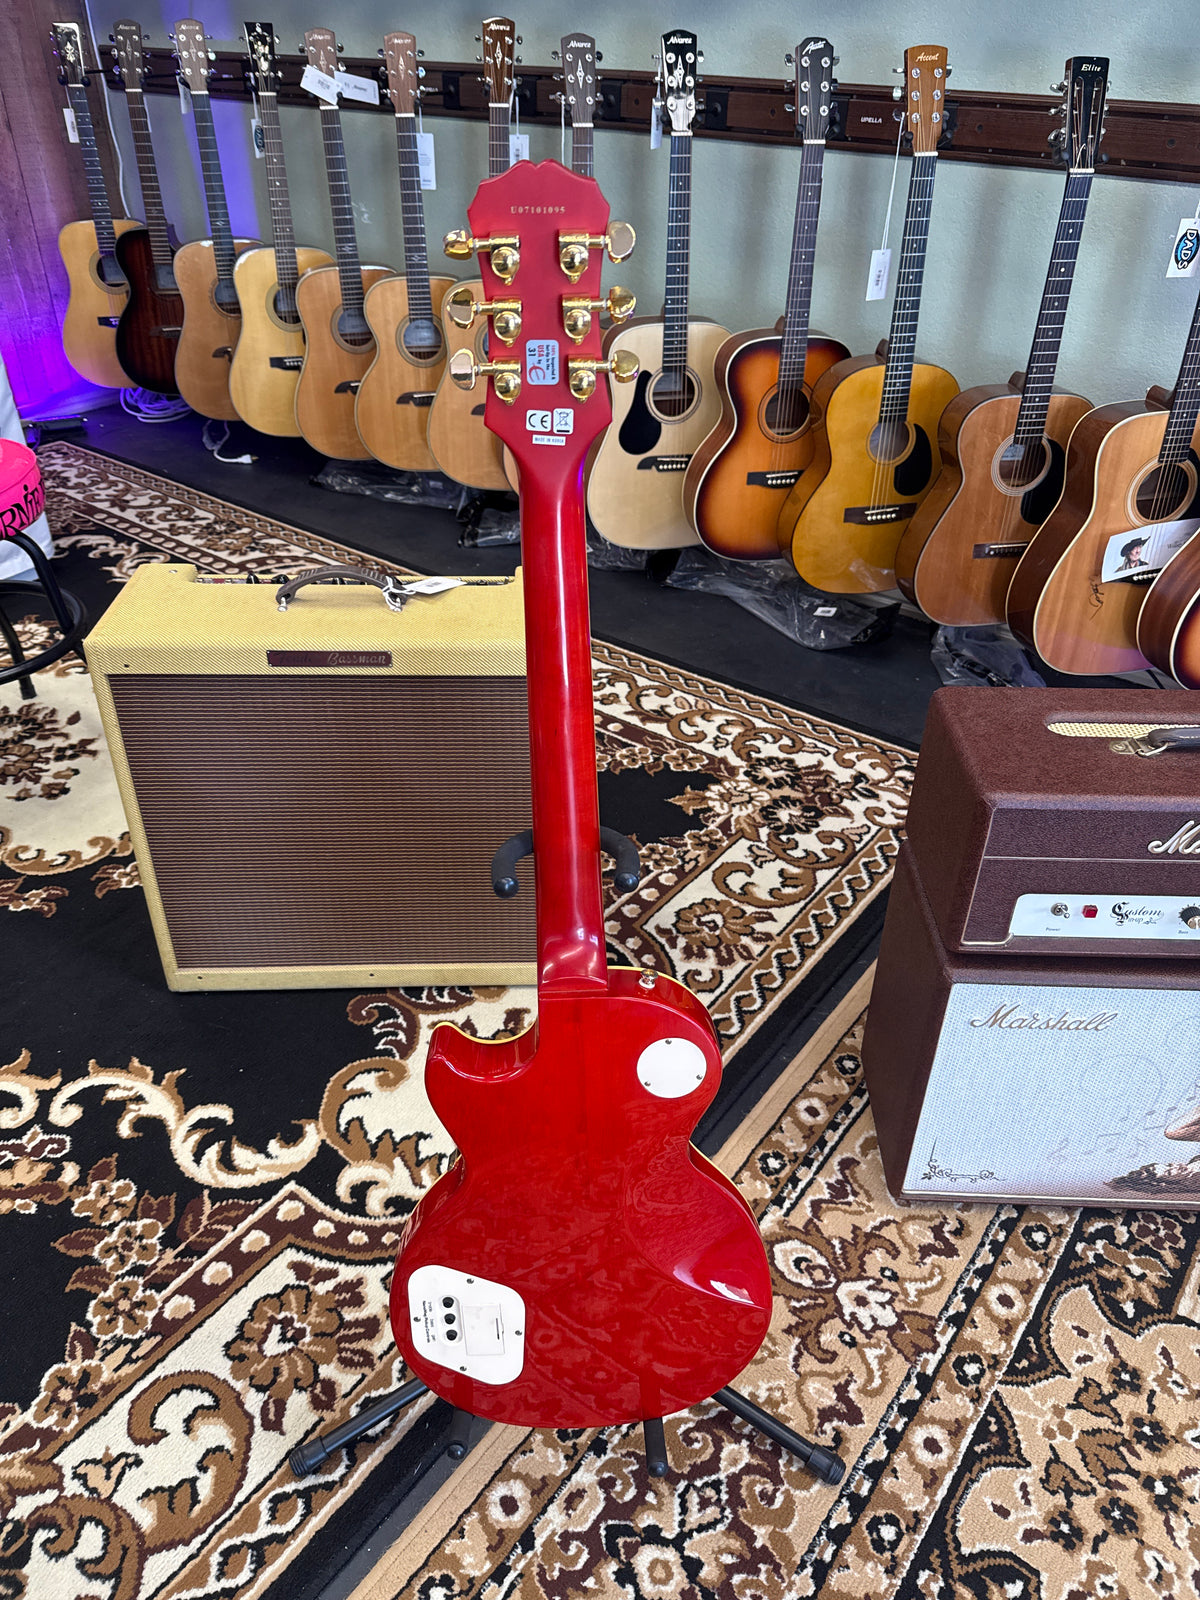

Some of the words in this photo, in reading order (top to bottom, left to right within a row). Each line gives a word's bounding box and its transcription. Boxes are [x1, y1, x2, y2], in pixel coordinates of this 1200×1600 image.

[567, 39, 592, 49] Alvarez
[666, 35, 693, 45] Alvarez
[915, 51, 940, 63] Accent
[1081, 63, 1103, 72] Elite
[1176, 228, 1199, 271] DADS
[528, 347, 536, 357] 31
[537, 344, 545, 358] USA
[327, 652, 387, 666] Bassman
[969, 1003, 1119, 1032] Marshall
